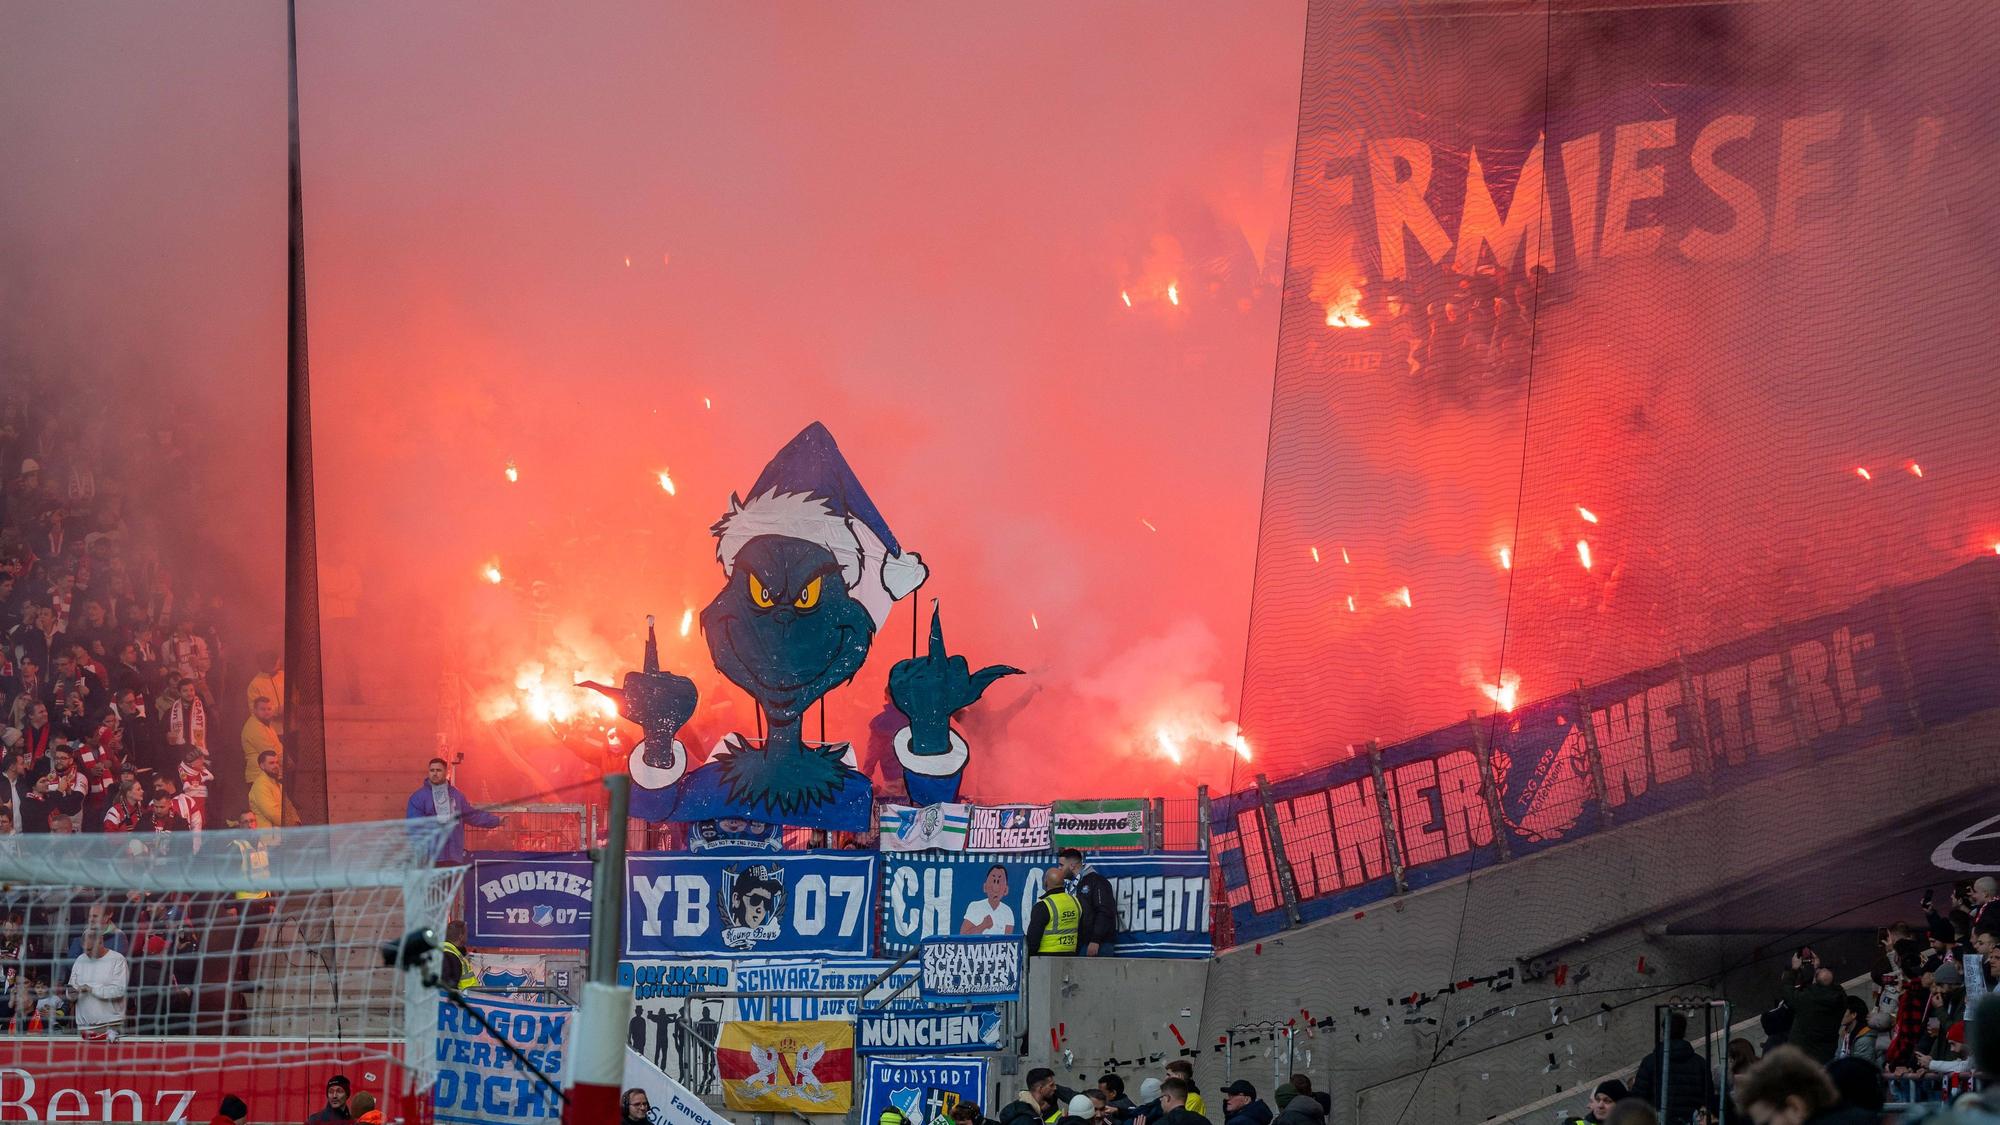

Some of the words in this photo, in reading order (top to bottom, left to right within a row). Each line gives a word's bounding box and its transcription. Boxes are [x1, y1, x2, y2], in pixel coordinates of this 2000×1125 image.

[1057, 817, 1127, 831] HOMBURG
[968, 827, 1051, 848] UNVERGESSE
[506, 908, 530, 923] YB
[556, 908, 578, 923] 07
[634, 875, 710, 937] YB
[792, 874, 866, 937] 07
[924, 943, 1018, 961] ZUSAMMEN
[924, 958, 1017, 978] SCHAFFEN
[737, 969, 820, 992] SCHWARZ
[822, 971, 845, 990] FÜR
[924, 972, 954, 989] WIR
[739, 997, 819, 1023] WALD
[820, 1000, 845, 1016] AUF
[438, 1002, 565, 1045] ROGON
[862, 1013, 979, 1046] MÜNCHEN
[436, 1038, 561, 1073] VERPISS
[881, 1068, 970, 1085] WEINSTADT
[434, 1069, 560, 1118] DICH!
